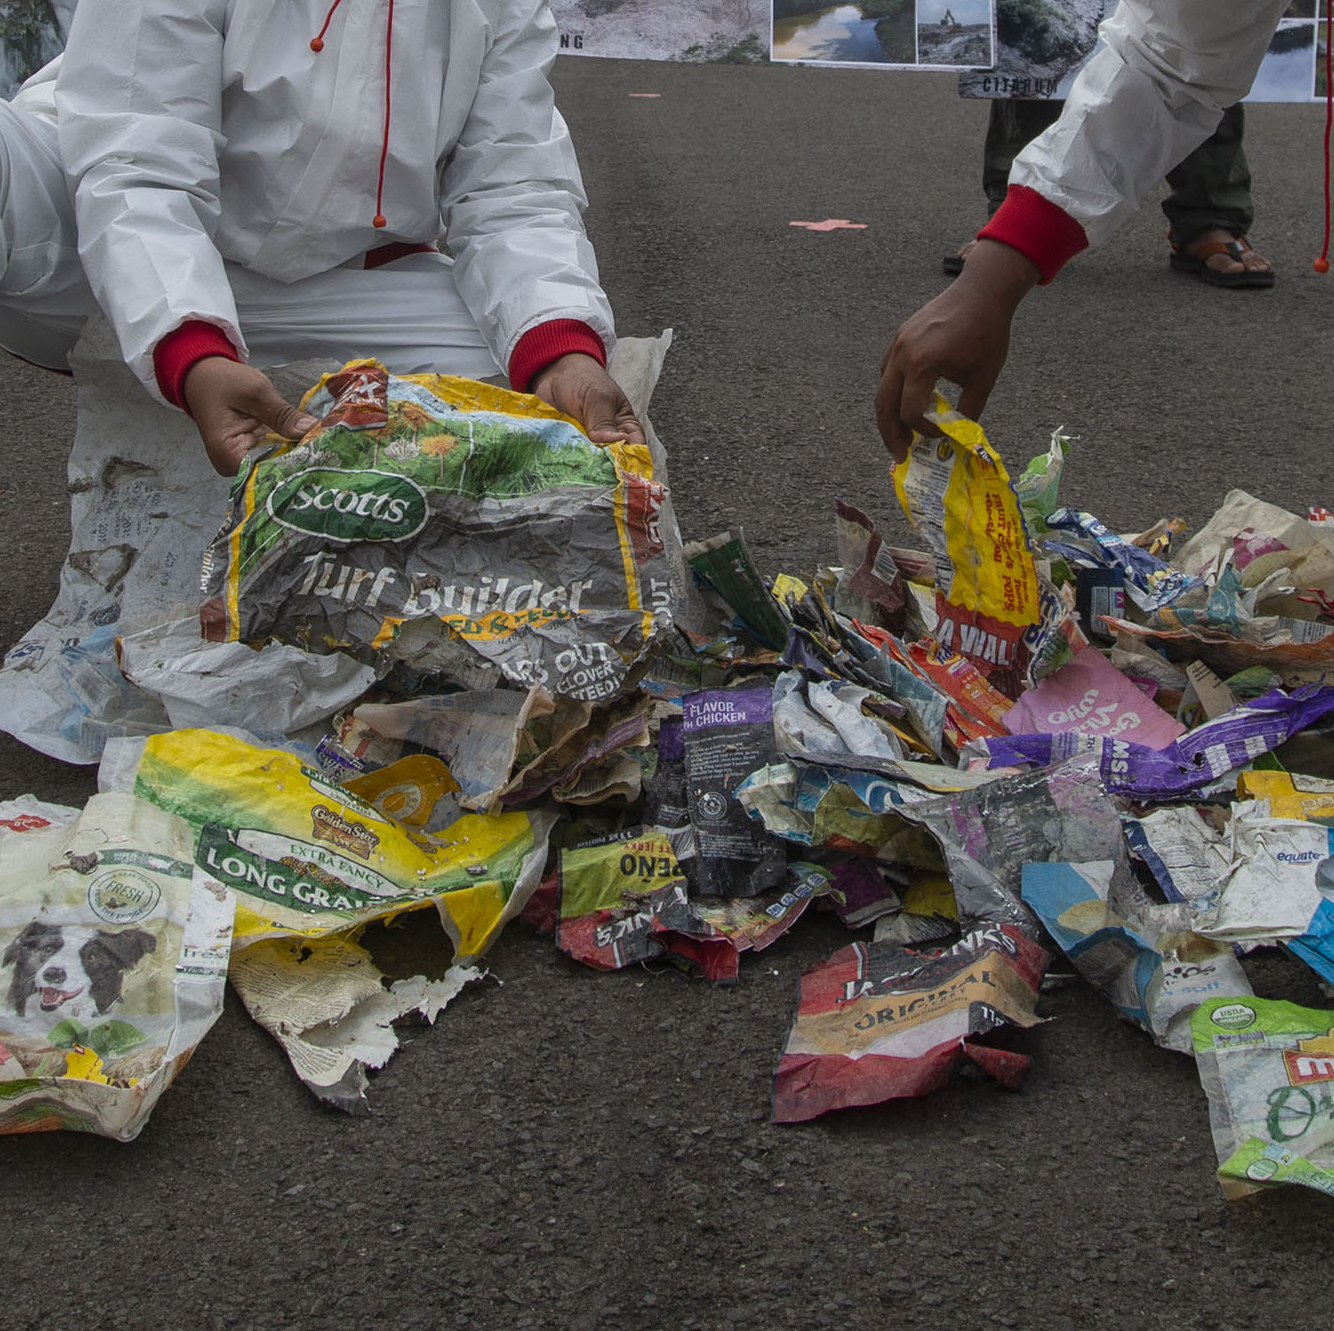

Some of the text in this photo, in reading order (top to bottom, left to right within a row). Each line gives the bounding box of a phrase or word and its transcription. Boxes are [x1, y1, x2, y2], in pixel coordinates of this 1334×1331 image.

[290, 482, 411, 525] Scotts
[298, 550, 595, 616] Turf Builder
[555, 642, 611, 674] OUT
[690, 701, 734, 717] FLAVOR
[696, 711, 747, 727] CHICKEN
[314, 807, 378, 848] Golden Star
[290, 844, 385, 890] EXTRA FANCY
[620, 853, 685, 883] PEÑO
[1277, 850, 1320, 864] equate
[105, 881, 145, 904] FRESH
[206, 847, 367, 911] LONG GRAI
[1220, 1008, 1245, 1017] USDA
